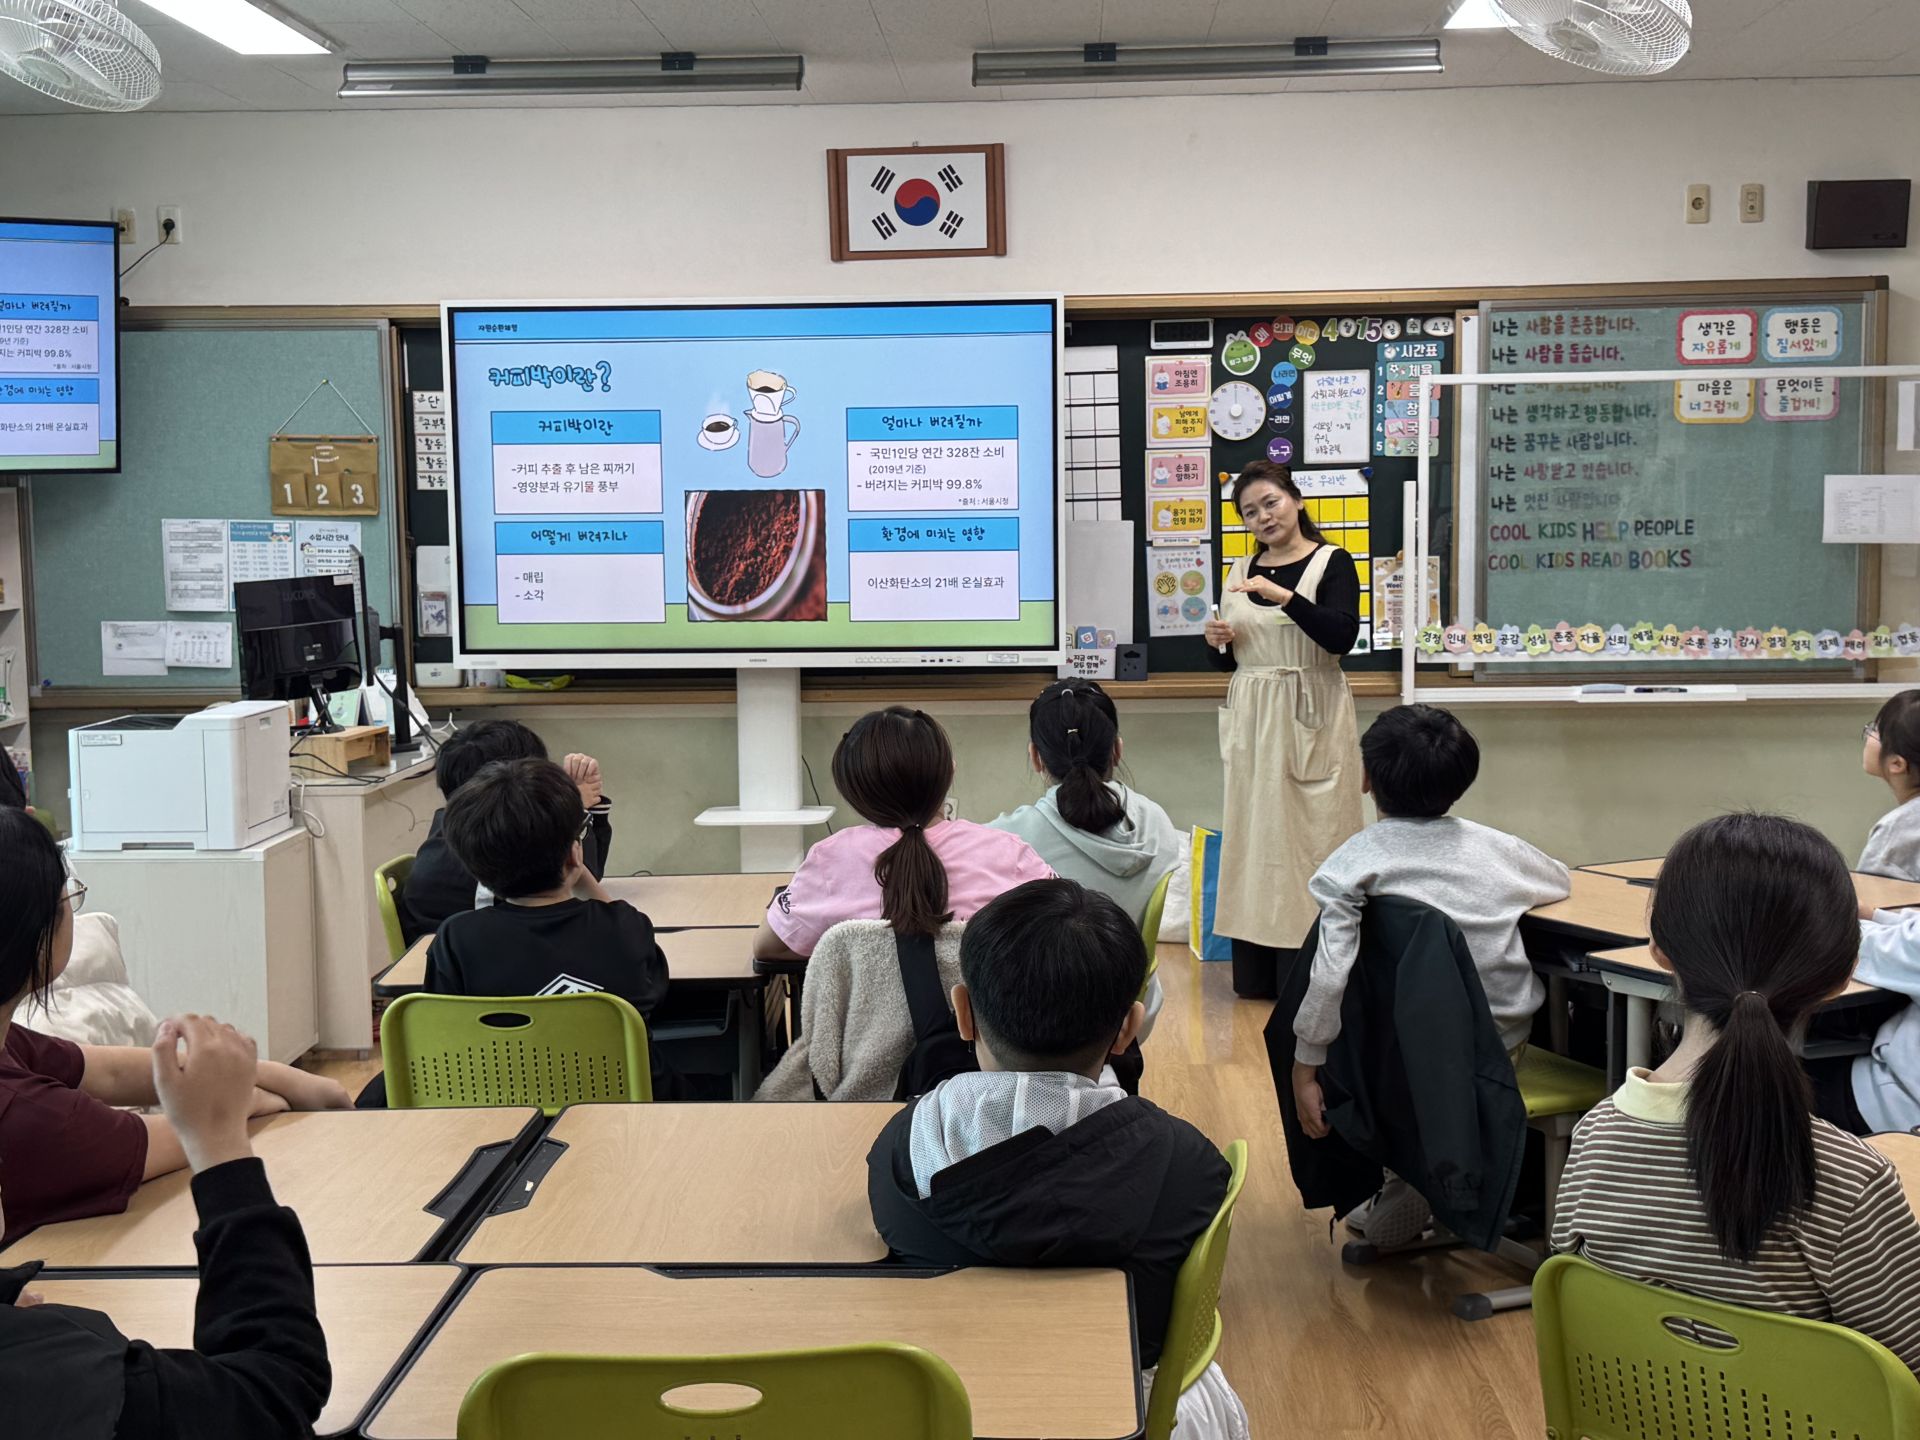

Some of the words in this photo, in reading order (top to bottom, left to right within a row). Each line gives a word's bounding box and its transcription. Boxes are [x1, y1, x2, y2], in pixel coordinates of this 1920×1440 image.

[32, 300, 72, 312] 버려질까
[0, 324, 22, 334] 1인당
[25, 325, 42, 334] 연간
[44, 325, 70, 334] 328잔
[72, 326, 88, 335] 소비
[1273, 322, 1294, 334] 언제
[1322, 318, 1339, 341] 4
[1356, 317, 1382, 342] 15
[1387, 323, 1397, 335] 일
[1409, 321, 1419, 331] 수
[1432, 321, 1450, 333] 요일
[1492, 318, 1518, 337] 나는
[1526, 314, 1565, 336] 사람을
[1569, 314, 1640, 336] 존중합니다.
[1698, 319, 1736, 337] 생각은
[1784, 317, 1821, 335] 행동은
[1254, 327, 1270, 343] 왜
[1295, 325, 1318, 340] 어디
[1401, 343, 1438, 358] 시간표
[1692, 338, 1741, 355] 자유롭게
[1776, 337, 1828, 354] 질서있게
[16, 349, 42, 358] 커피박
[44, 349, 72, 358] 99.8%
[1291, 347, 1313, 365] 무엇
[1492, 345, 1518, 365] 나는
[1525, 343, 1565, 364] 사람을
[1568, 343, 1625, 364] 돕습니다.
[488, 360, 612, 393] 커피박이란?
[1174, 369, 1198, 379] 아침엔
[1274, 369, 1296, 378] 나라면
[1377, 366, 1383, 376] 1
[28, 386, 52, 397] 미치는
[56, 384, 74, 397] 영향
[1174, 380, 1198, 388] 조용히
[1377, 385, 1384, 395] 2
[1698, 379, 1732, 395] 마음은
[1776, 377, 1824, 393] 무엇이든
[1269, 391, 1293, 404] 어떻게
[1779, 395, 1821, 413] 즐겁게!
[1376, 404, 1383, 414] 3
[1492, 405, 1519, 424] 나는
[1526, 404, 1581, 423] 생각하고
[1583, 403, 1657, 423] 행동합니다.
[1689, 400, 1740, 414] 너그럽게
[35, 422, 54, 432] 21배
[56, 422, 88, 432] 온실효과
[538, 418, 614, 437] 커피박이란
[882, 415, 923, 431] 얼마나
[930, 414, 983, 429] 버려질까
[1376, 422, 1384, 433] 4
[1376, 441, 1383, 451] 5
[1490, 434, 1517, 453] 나는
[1524, 432, 1562, 452] 꿈꾸는
[1566, 431, 1637, 451] 사람입니다.
[870, 447, 918, 460] 국민1인당
[921, 447, 943, 459] 연간
[946, 447, 980, 459] 328잔
[983, 446, 1005, 458] 소비
[1269, 446, 1291, 456] 누구
[541, 462, 562, 476] 추출
[565, 463, 576, 475] 후
[578, 462, 600, 475] 남은
[602, 462, 636, 475] 찌꺼기
[868, 464, 904, 476] (2019년
[906, 464, 927, 475] 기준)
[1175, 463, 1199, 472] 손들고
[1490, 463, 1516, 482] 나는
[1523, 461, 1577, 481] 사랑받고
[1175, 473, 1199, 482] 말하기
[1318, 475, 1347, 487] 우리반
[563, 480, 595, 494] 유기물
[597, 480, 619, 493] 풍부
[865, 479, 909, 492] 버려지는
[911, 479, 944, 491] 커피박
[946, 479, 983, 490] 99.8%
[283, 483, 293, 504] 1
[315, 484, 330, 504] 2
[350, 484, 364, 505] 3
[981, 497, 1009, 506] 서울시청
[1491, 494, 1517, 513] 나는
[1524, 492, 1550, 511] 멋진
[1188, 516, 1203, 524] 하기
[530, 529, 571, 546] 어떻게
[577, 530, 628, 543] 버려지나
[881, 525, 920, 542] 환경에
[926, 527, 956, 543] 미치는
[962, 525, 986, 542] 영향
[1490, 524, 1531, 542] COOL
[1538, 522, 1577, 540] KIDS
[1582, 521, 1629, 543] HELP
[1634, 519, 1694, 537] PEOPLE
[309, 534, 335, 542] 수업시간
[1488, 553, 1529, 570] COOL
[1536, 552, 1575, 569] KIDS
[1581, 552, 1623, 569] READ
[1628, 549, 1692, 570] BOOKS
[522, 571, 544, 584] 매립
[867, 577, 931, 590] 이산화탄소의
[935, 576, 959, 588] 21배
[961, 576, 1005, 589] 온실효과
[523, 589, 545, 601] 소각
[1447, 633, 1467, 645] 인내
[1472, 632, 1493, 644] 책임
[1500, 633, 1520, 646] 공감
[1527, 634, 1547, 647] 성실
[1553, 631, 1575, 643] 존중
[1580, 632, 1601, 644] 자율
[1607, 633, 1627, 646] 신뢰
[1632, 630, 1654, 642] 예절
[1659, 634, 1680, 647] 사랑
[1685, 636, 1706, 649] 소통
[1739, 635, 1760, 649] 감사
[1766, 636, 1787, 648] 열정
[1872, 634, 1893, 647] 질서
[1897, 631, 1919, 646] 협동
[1711, 637, 1732, 649] 용기
[1791, 639, 1811, 651] 정직
[1817, 637, 1840, 651] 절제
[1844, 639, 1866, 651] 배려
